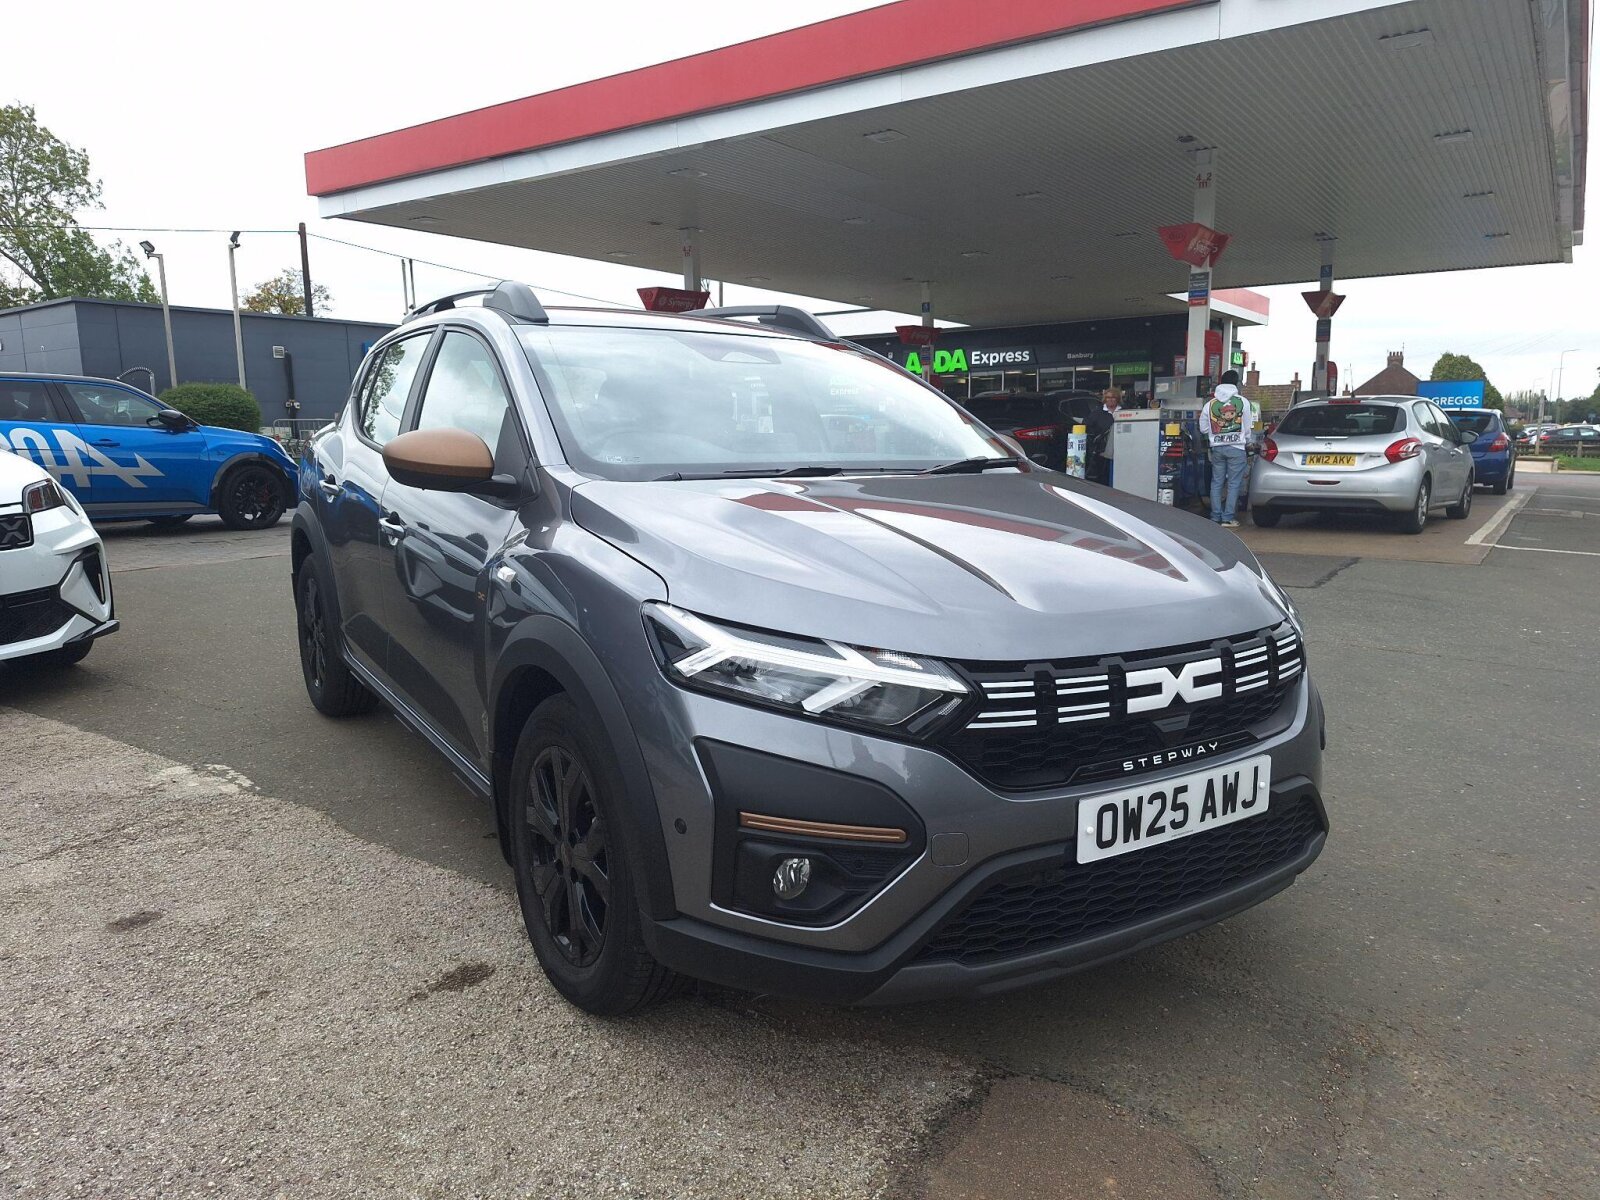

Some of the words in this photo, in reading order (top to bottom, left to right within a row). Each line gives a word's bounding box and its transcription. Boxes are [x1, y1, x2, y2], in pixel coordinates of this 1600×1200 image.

[904, 349, 968, 374] ADA
[971, 350, 1030, 366] Express
[1067, 352, 1094, 360] Banbury
[1431, 396, 1479, 405] GREGGS
[1309, 455, 1330, 464] KW12
[1333, 455, 1351, 464] AKV
[1122, 741, 1219, 771] STEPWAY
[1095, 784, 1190, 850] OW25
[1199, 765, 1259, 823] AWJ
